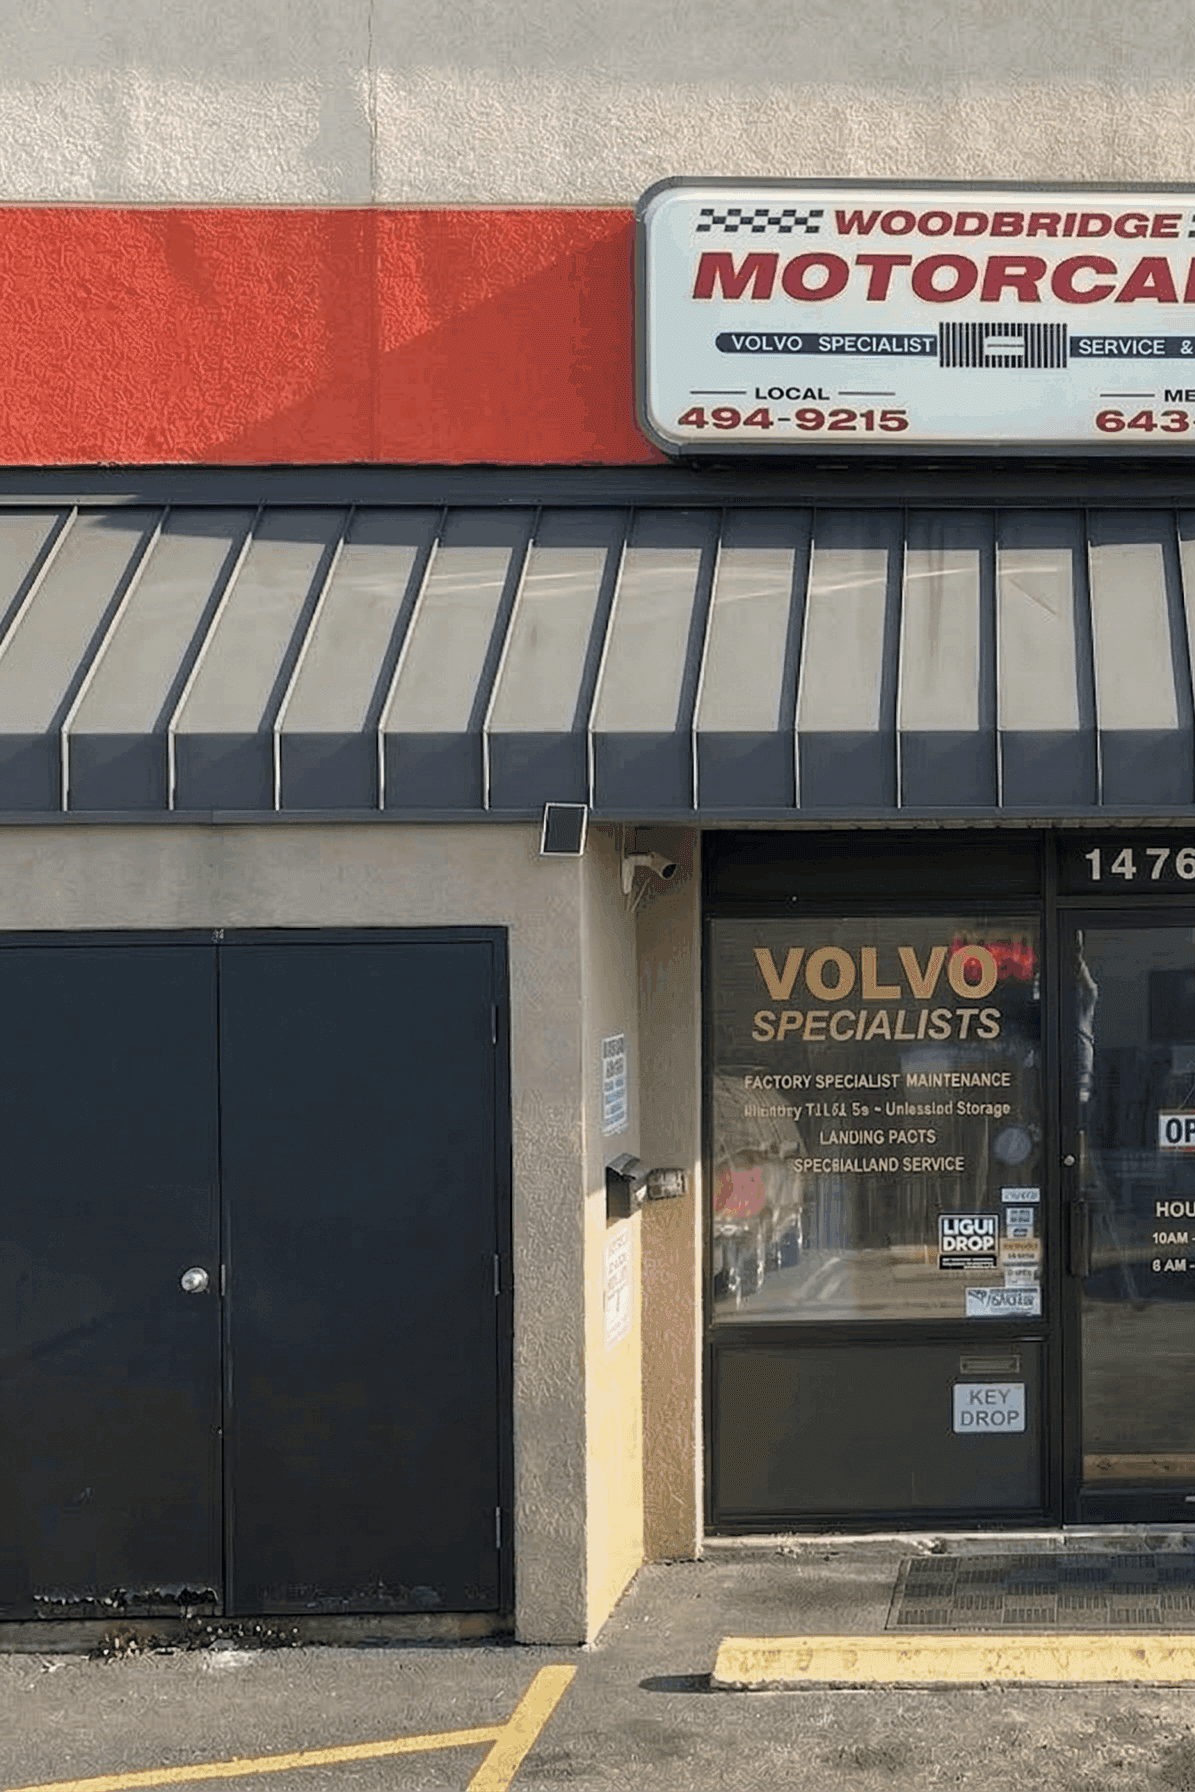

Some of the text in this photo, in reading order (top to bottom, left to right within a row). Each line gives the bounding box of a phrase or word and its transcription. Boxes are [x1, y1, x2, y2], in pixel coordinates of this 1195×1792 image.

[835, 209, 1182, 238] WOODBRIDGE
[731, 335, 934, 353] VOLVO SPECIALIST
[1078, 340, 1166, 354] SERVICE
[1180, 340, 1193, 354] &
[755, 387, 830, 400] LOCAL
[678, 407, 909, 431] 494-9215
[753, 945, 998, 1001] VOLVO
[752, 1007, 1001, 1042] SPECIALISTS
[744, 1072, 1012, 1090] FACTORY SPECIALIST MAINTENANCE
[820, 1129, 937, 1145] LANDING PACTS
[902, 1156, 965, 1172] SERVICE
[942, 1236, 995, 1252] DROP
[1152, 1231, 1189, 1245] 10AM
[1164, 1258, 1187, 1272] AM
[969, 1388, 1011, 1405] KEY
[960, 1410, 1020, 1427] DROP
